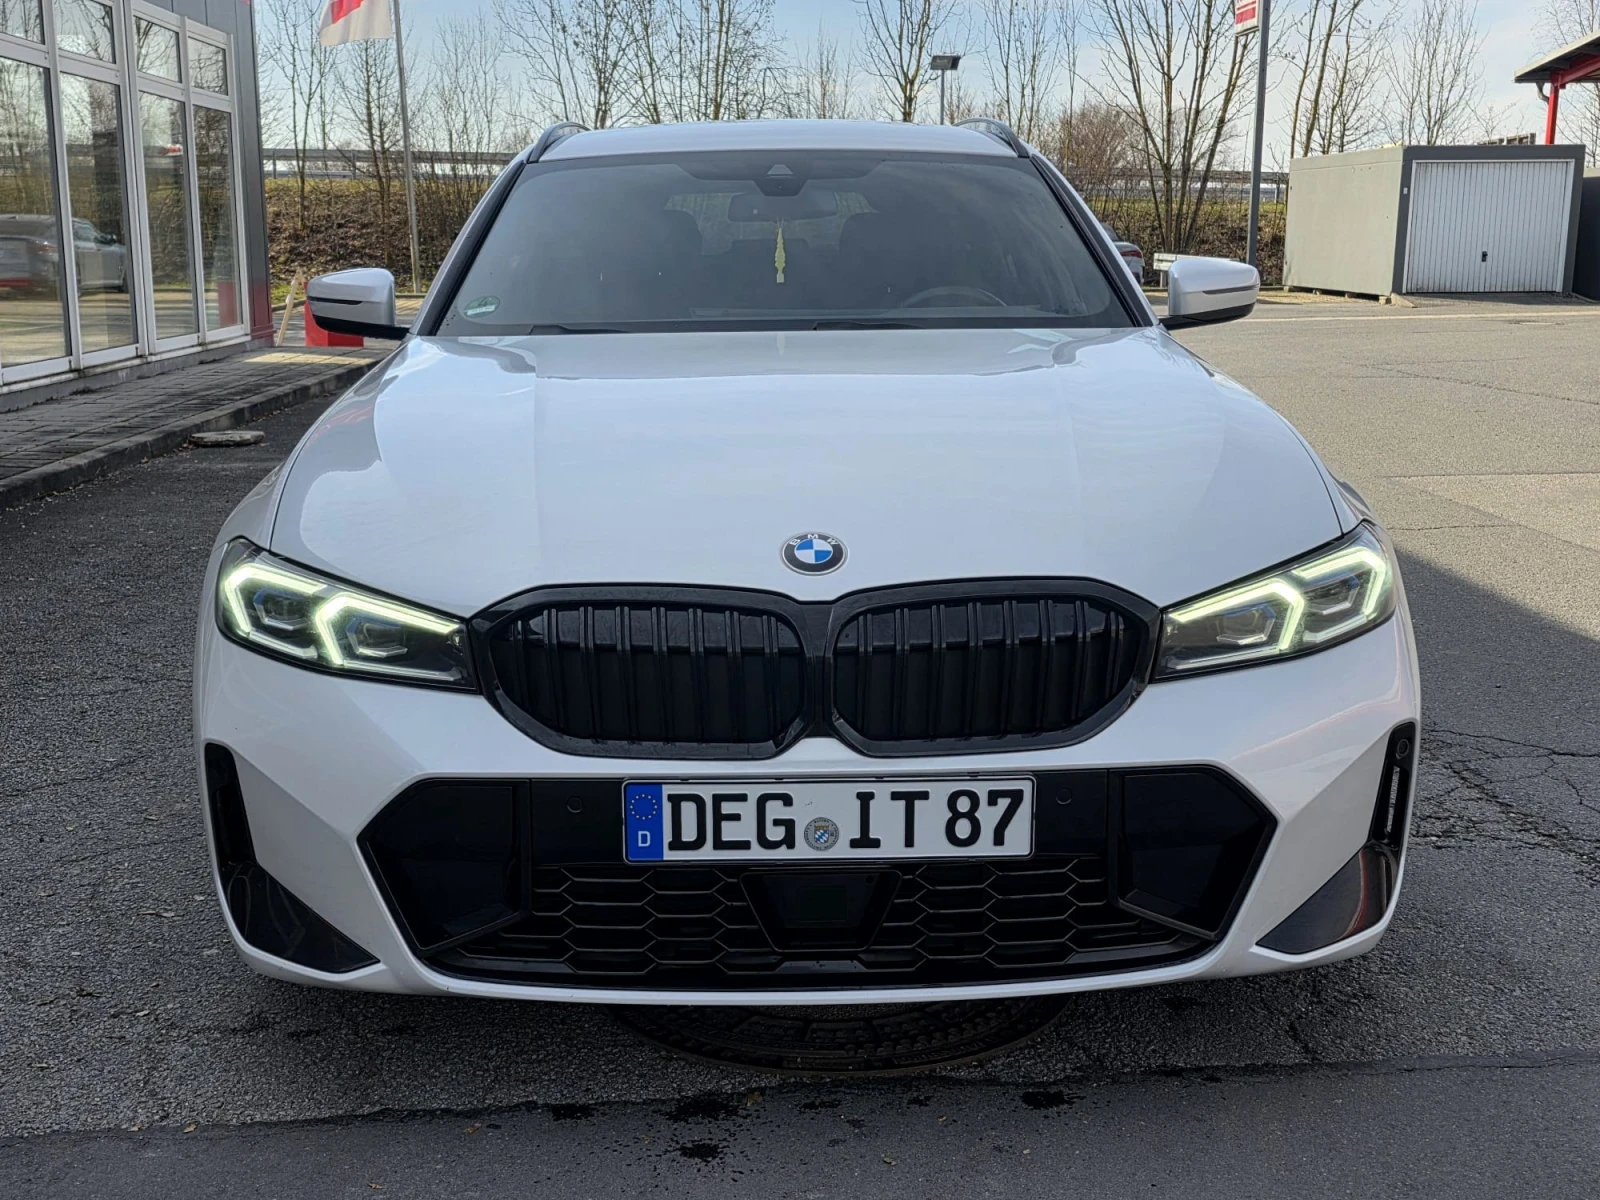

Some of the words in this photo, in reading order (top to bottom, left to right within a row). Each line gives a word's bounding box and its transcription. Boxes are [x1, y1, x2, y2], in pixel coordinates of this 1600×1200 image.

[789, 533, 839, 545] BMW
[667, 792, 796, 851] DEG
[849, 790, 930, 849] IT
[944, 788, 1025, 848] 87
[637, 831, 651, 847] D
